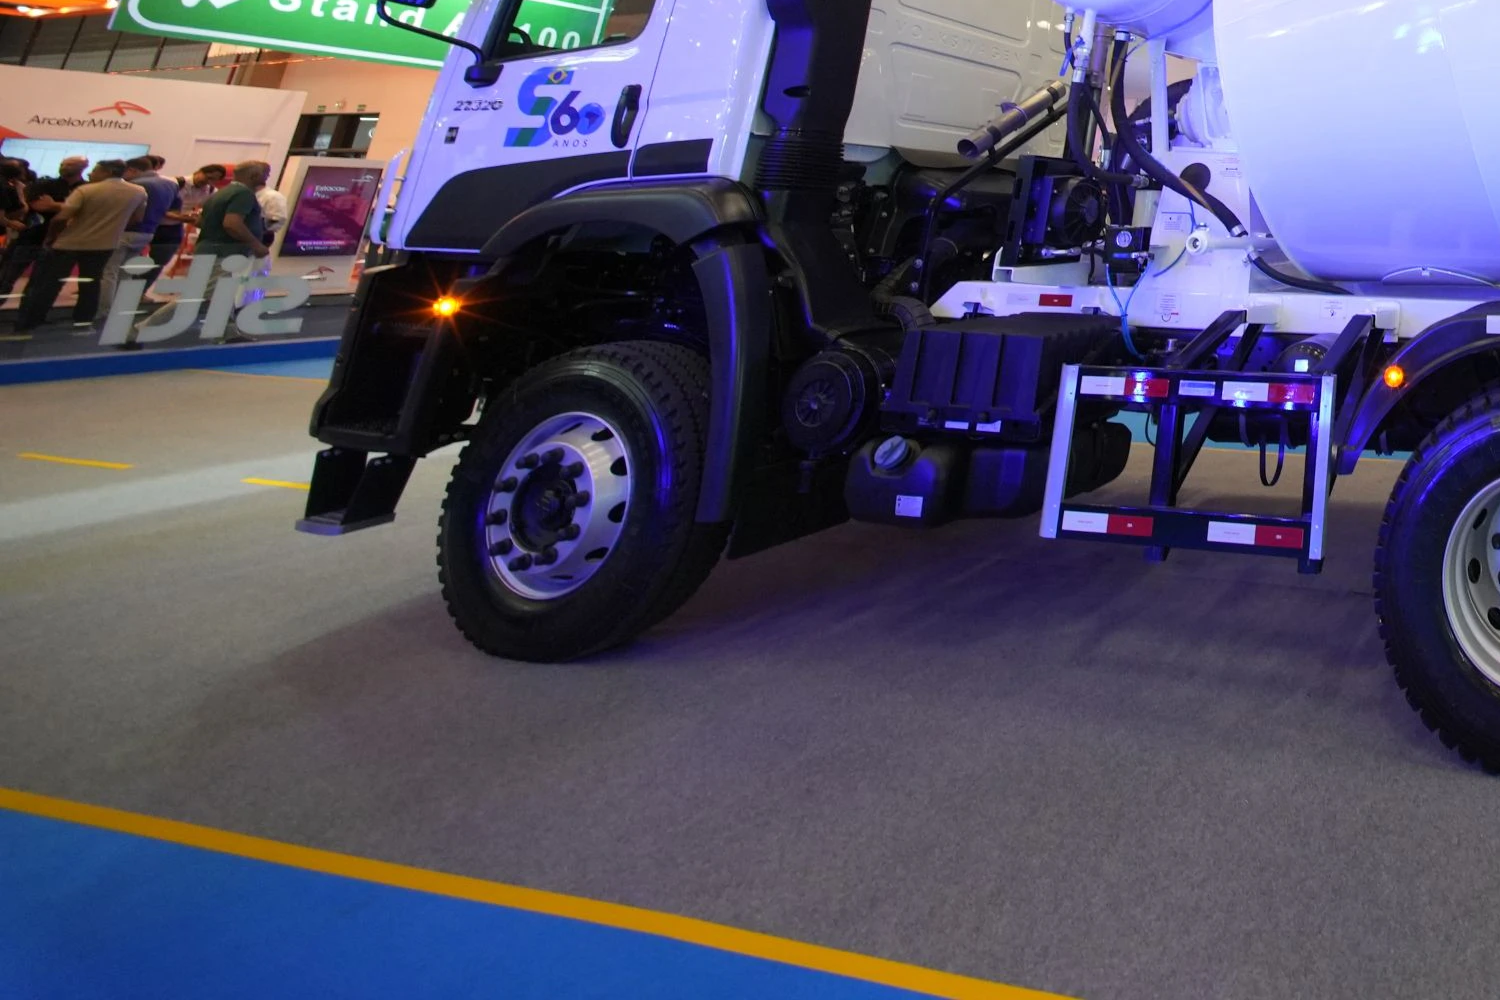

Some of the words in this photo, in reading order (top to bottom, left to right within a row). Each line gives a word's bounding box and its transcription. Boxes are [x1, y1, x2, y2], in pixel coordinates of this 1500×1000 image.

[895, 19, 1025, 65] VOLKSWAGEN
[28, 114, 133, 129] ArcelorMittal
[553, 139, 589, 147] ANOS
